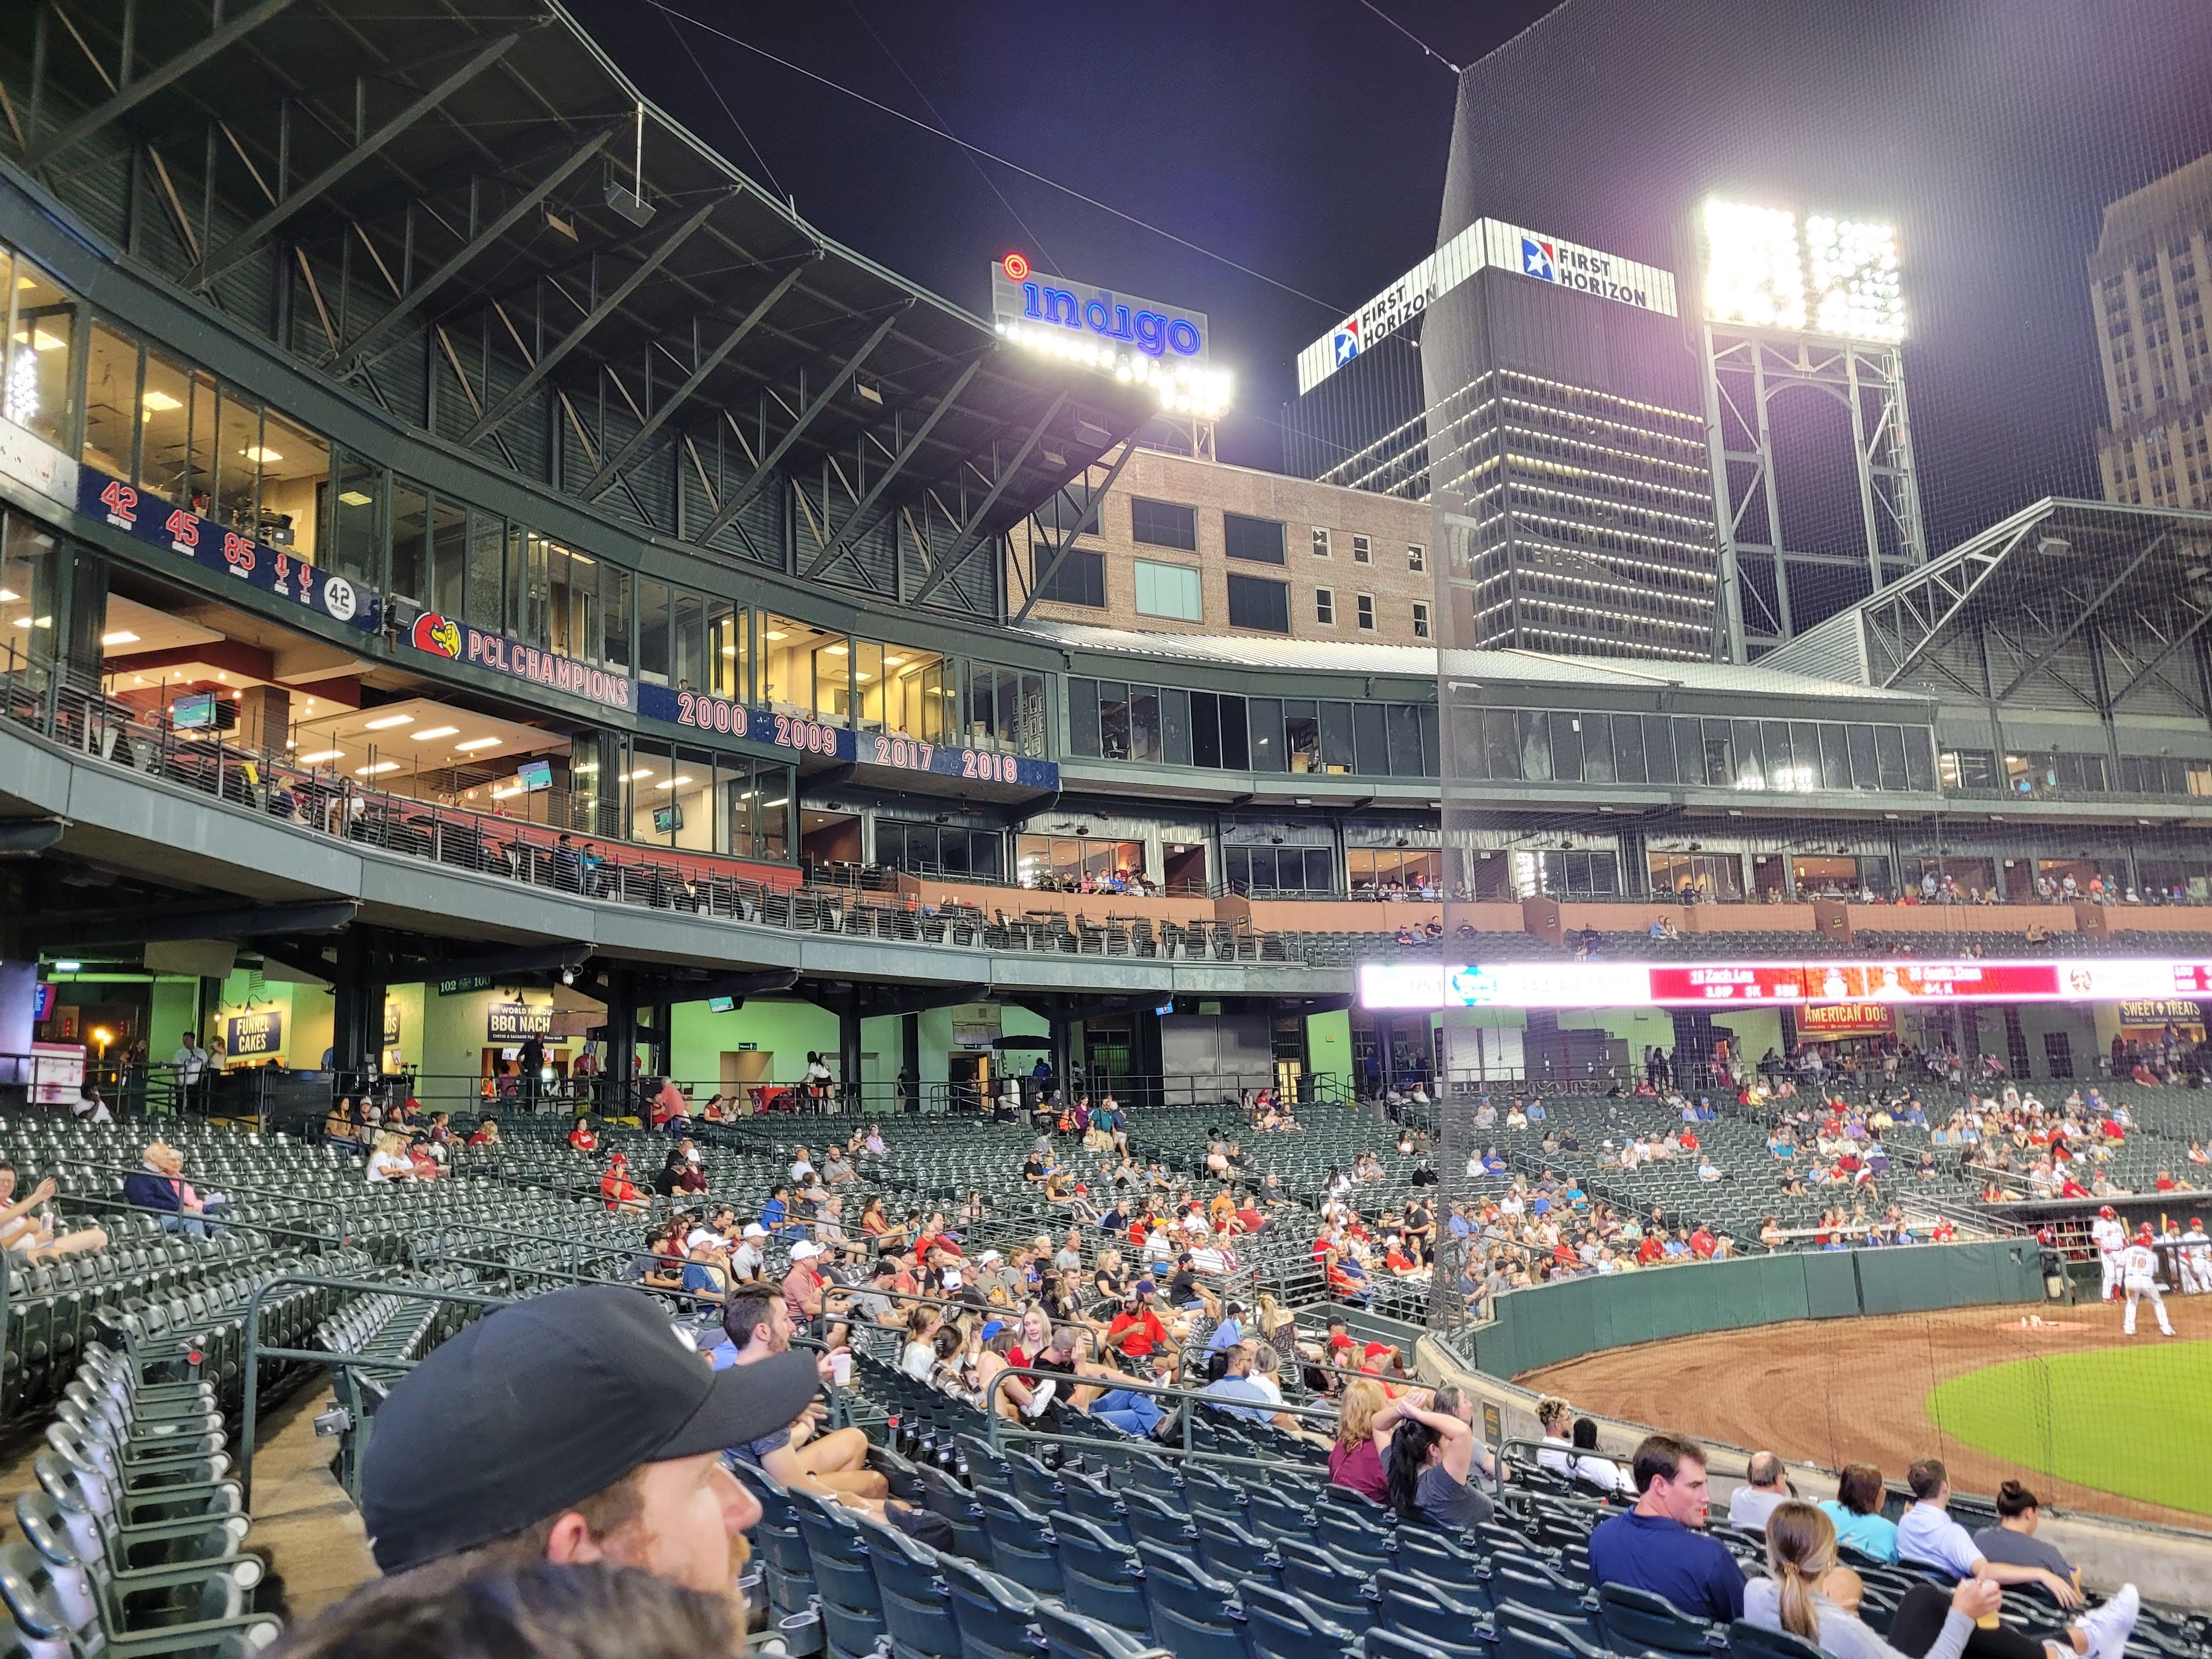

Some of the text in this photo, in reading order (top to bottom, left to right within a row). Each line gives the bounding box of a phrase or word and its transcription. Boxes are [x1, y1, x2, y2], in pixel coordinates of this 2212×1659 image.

[1559, 247, 1611, 276] FIRST
[1561, 268, 1647, 307] HORIZON
[1024, 282, 1200, 357] indigo
[1363, 284, 1407, 328] FIRST
[1364, 282, 1437, 348] HORIZON
[101, 481, 138, 522] 42
[166, 509, 199, 547] 45
[224, 532, 256, 570] 85
[329, 584, 350, 609] 42
[469, 629, 629, 707] PCL CHAMPIONS
[677, 691, 748, 737] 2000
[774, 715, 837, 757] 2009
[874, 736, 934, 771] 2017
[961, 749, 1018, 783] 2018
[441, 975, 490, 992] 102 100
[236, 1015, 270, 1036] FUNNEL
[491, 1015, 551, 1033] BBQ NACH
[501, 1007, 553, 1015] WORLD FAMOU
[1804, 1005, 1888, 1023] AMERICAN DOG
[2123, 1001, 2200, 1017] SWEET TREATS
[239, 1033, 267, 1053] CAKES
